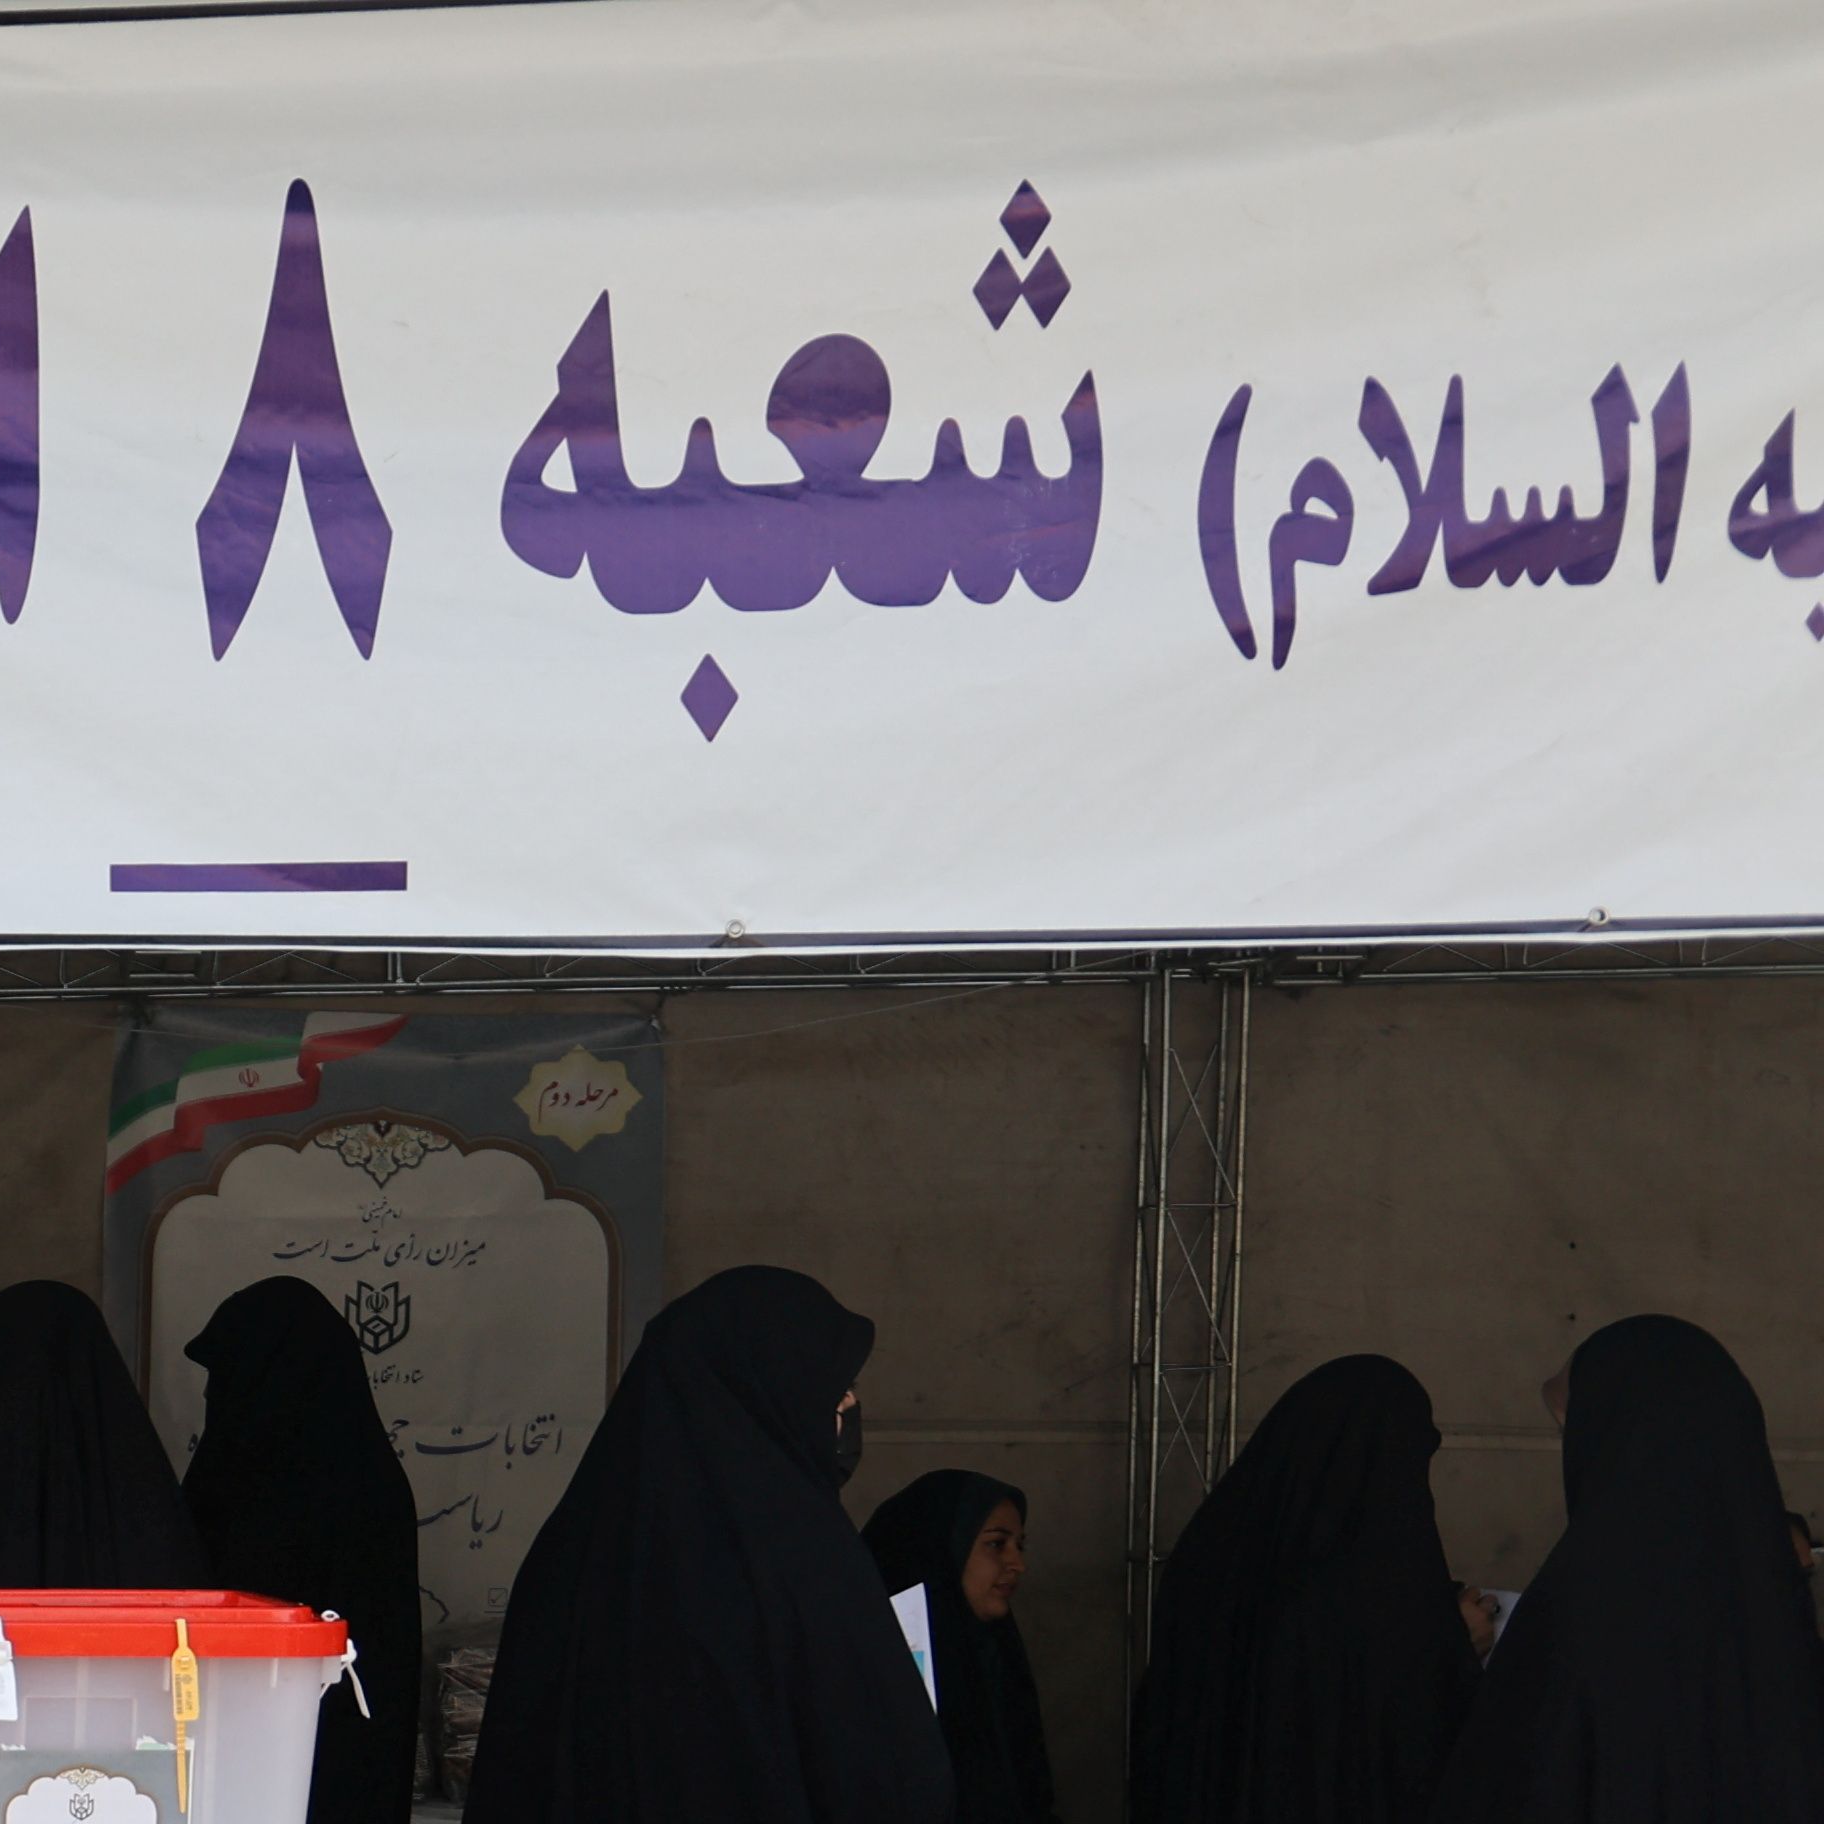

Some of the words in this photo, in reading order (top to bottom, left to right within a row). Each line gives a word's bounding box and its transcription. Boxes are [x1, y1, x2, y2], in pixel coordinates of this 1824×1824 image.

[197, 178, 392, 663] ۸
[501, 178, 1104, 745] شعبه
[538, 1081, 571, 1124] دوم
[574, 1082, 619, 1112] مرحله
[271, 1237, 330, 1259] است
[425, 1237, 487, 1269] میزان
[367, 1364, 400, 1389] انتخابا
[414, 1412, 564, 1470] انتخابات
